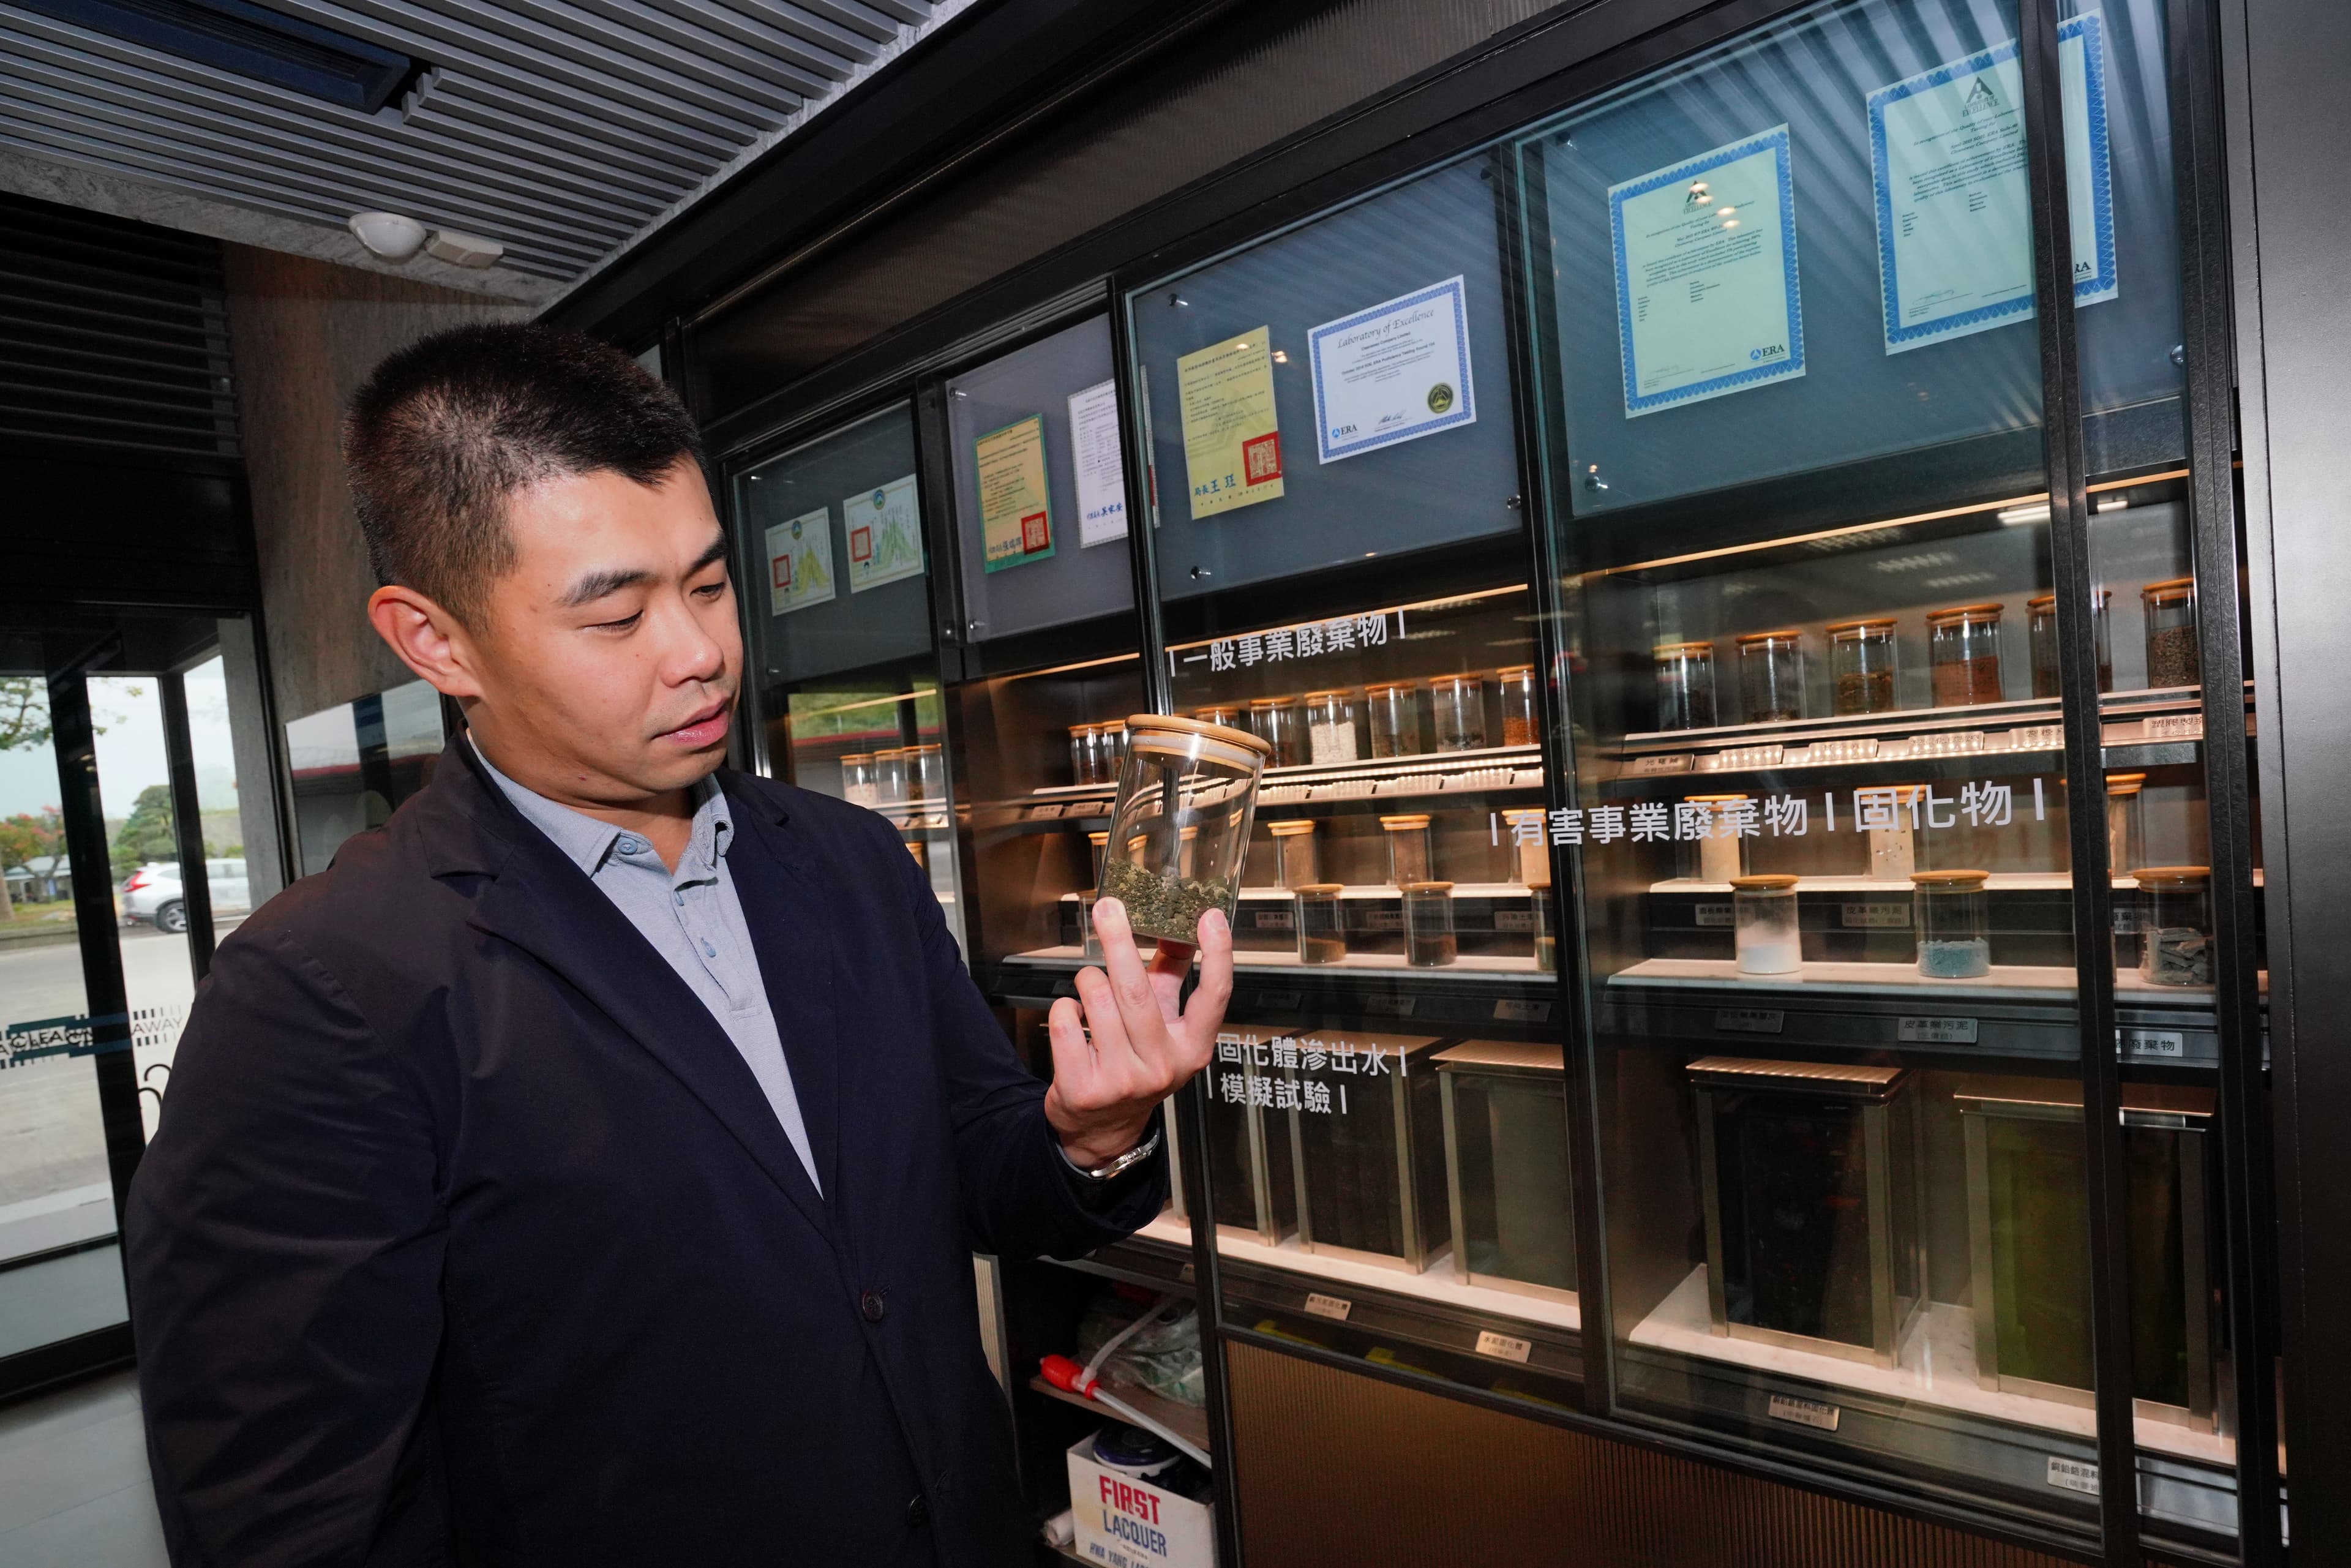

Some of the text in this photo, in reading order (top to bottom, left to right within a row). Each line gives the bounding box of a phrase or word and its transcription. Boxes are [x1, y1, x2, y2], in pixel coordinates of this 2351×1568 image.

[1337, 309, 1434, 348] Laboratory of Excellence
[1763, 344, 1785, 357] ERA
[1341, 424, 1357, 435] ERA
[1183, 612, 1387, 672] 一般事業廢棄物
[1511, 793, 1808, 847] 有害事業廢棄物
[1853, 779, 2013, 833] 固化物
[1217, 1032, 1391, 1077] 固化體滲出水
[1220, 1072, 1332, 1115] 模擬試驗
[1099, 1474, 1161, 1525] FIRST
[1103, 1509, 1167, 1558] LACQUER
